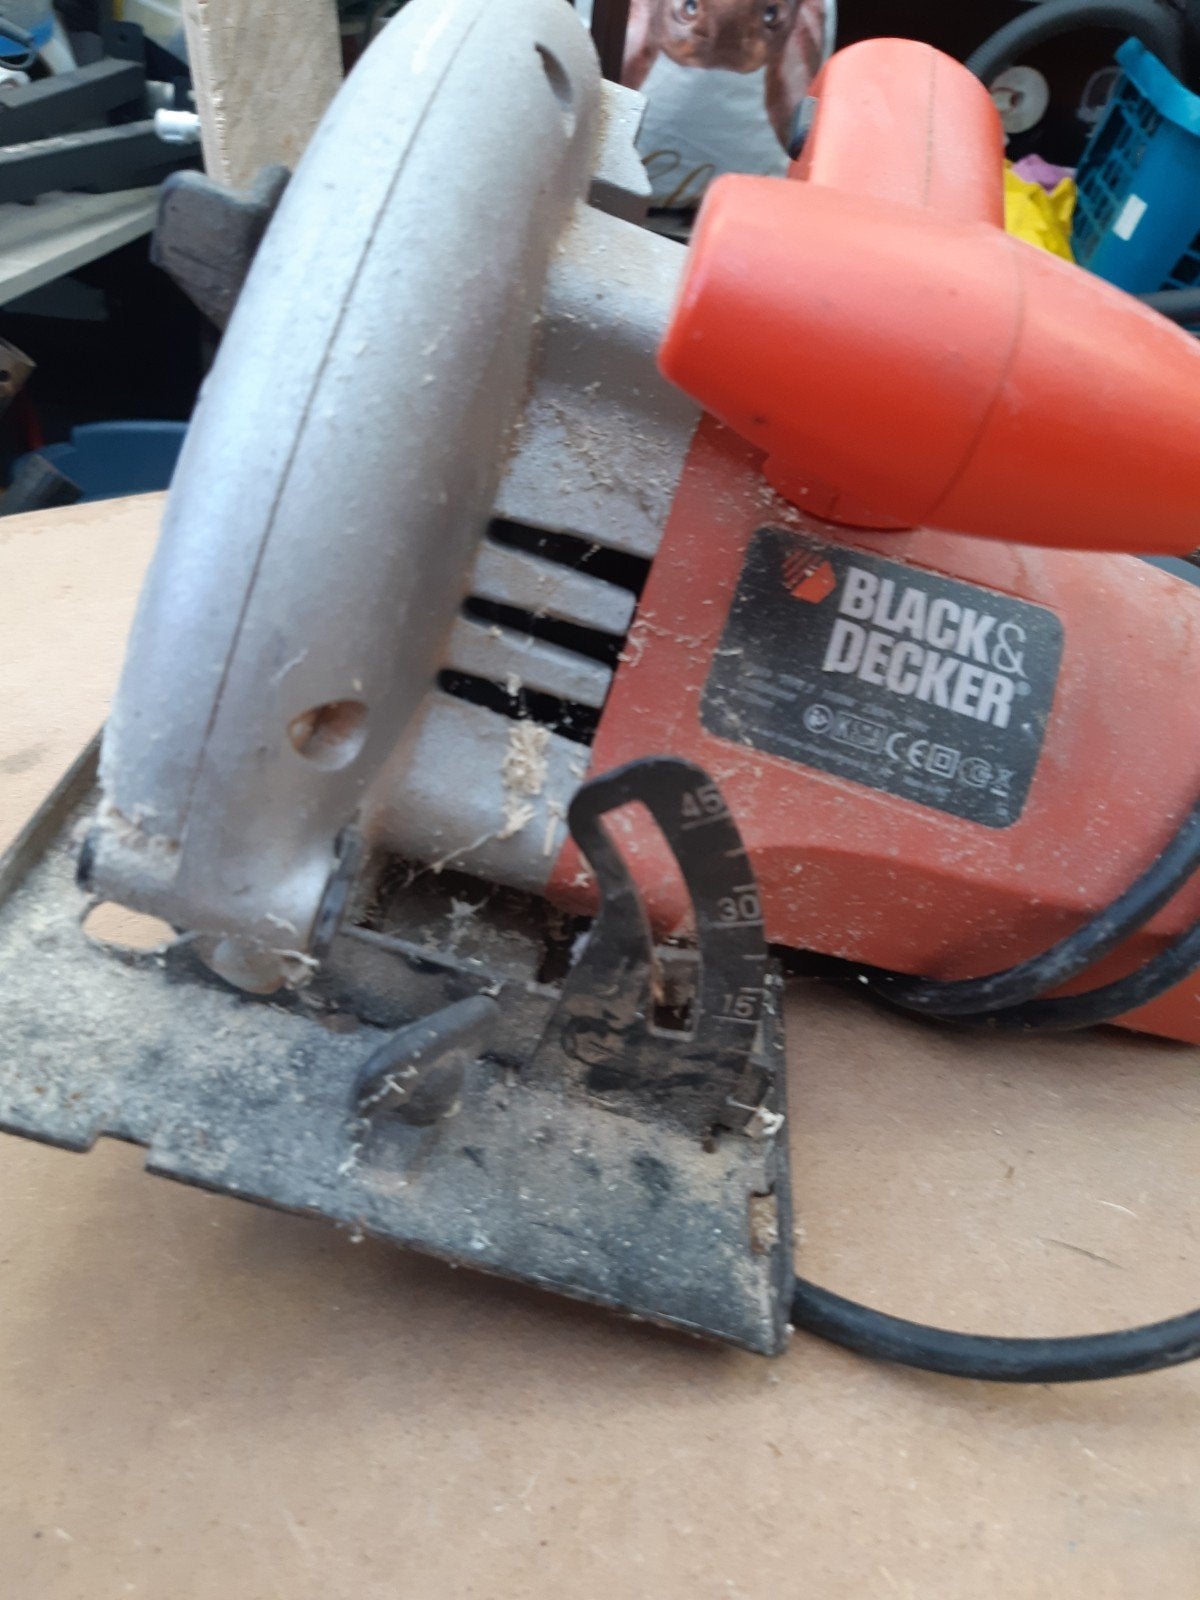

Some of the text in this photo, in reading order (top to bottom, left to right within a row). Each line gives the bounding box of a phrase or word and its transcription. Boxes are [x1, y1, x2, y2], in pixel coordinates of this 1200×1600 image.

[822, 618, 1016, 729] DECKER
[885, 732, 930, 769] CE
[681, 785, 723, 818] 45
[717, 894, 761, 922] 30
[721, 993, 757, 1018] 15
